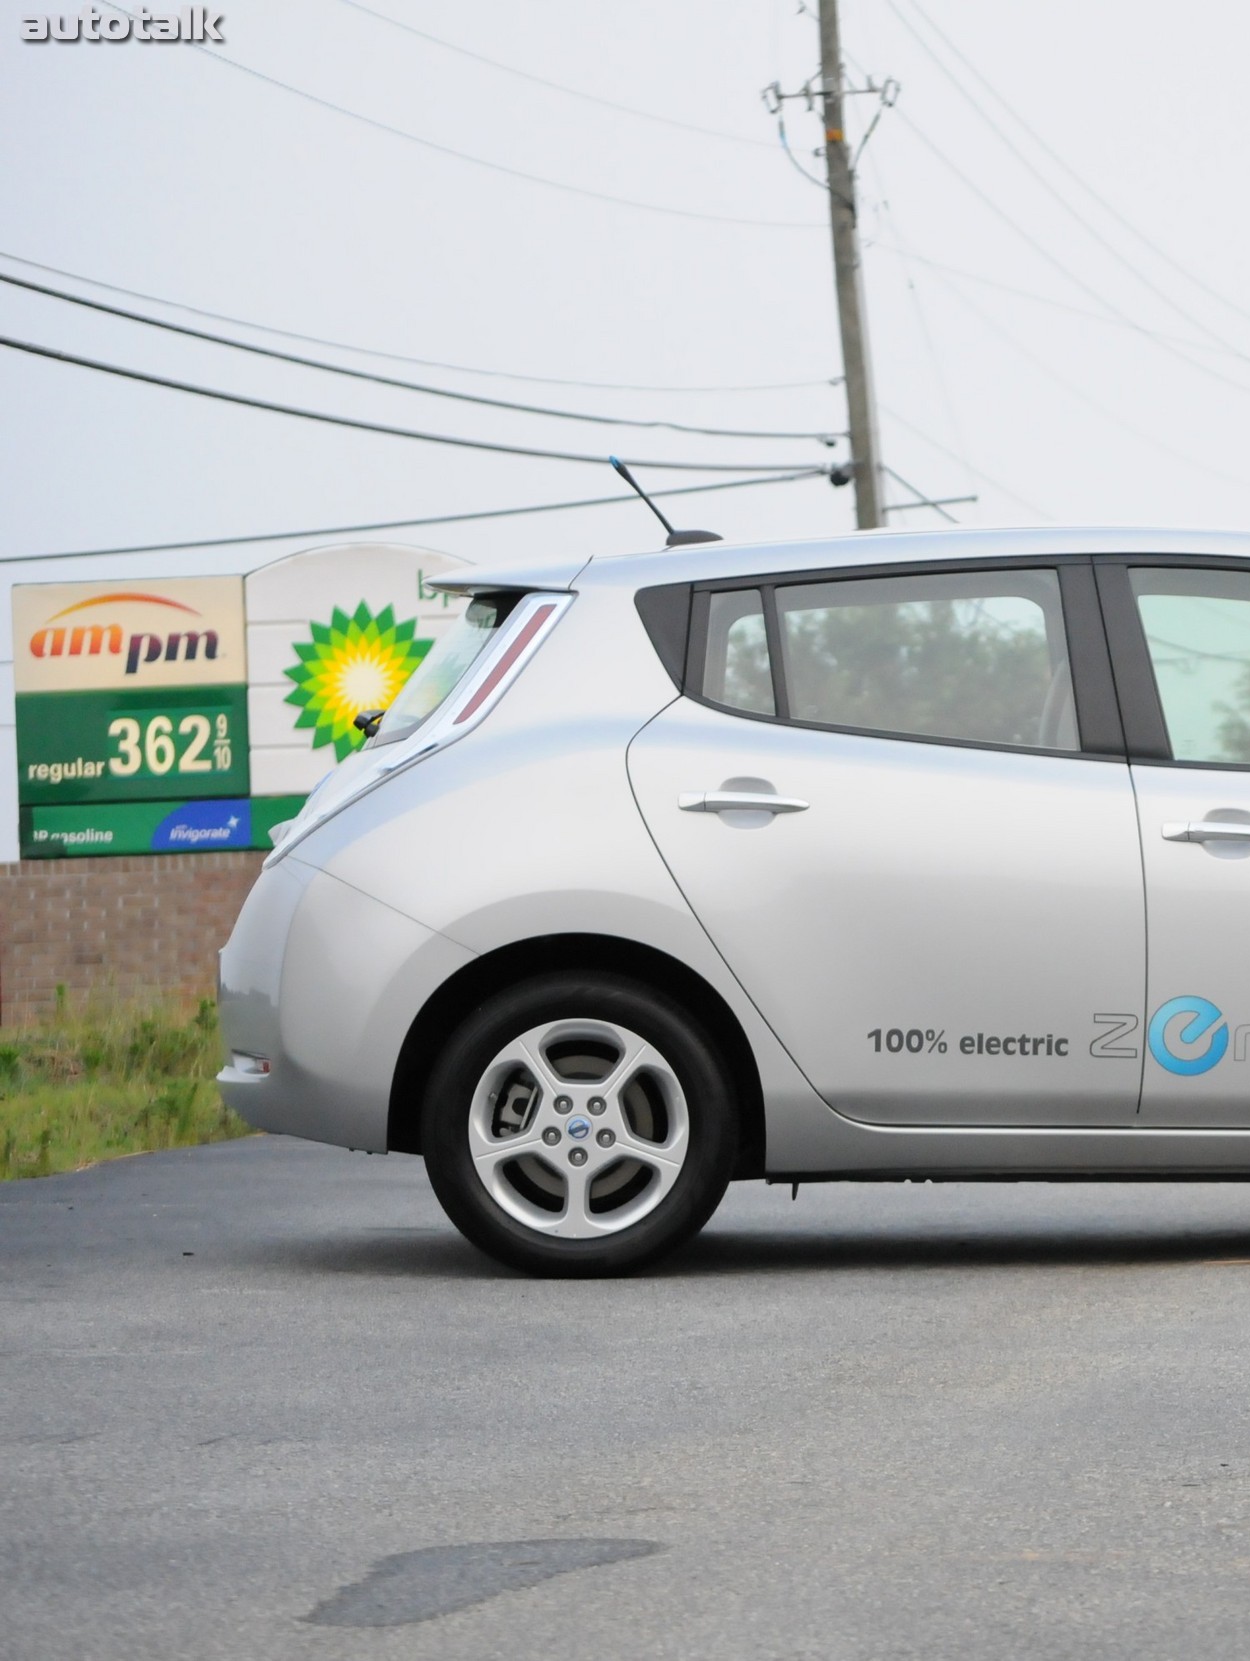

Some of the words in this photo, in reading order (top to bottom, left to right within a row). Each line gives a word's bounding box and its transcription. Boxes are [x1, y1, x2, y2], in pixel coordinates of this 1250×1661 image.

[30, 623, 220, 674] ampm
[28, 757, 105, 784] regular
[108, 714, 213, 778] 362
[867, 1029, 948, 1054] 100%
[959, 1033, 1069, 1056] electric
